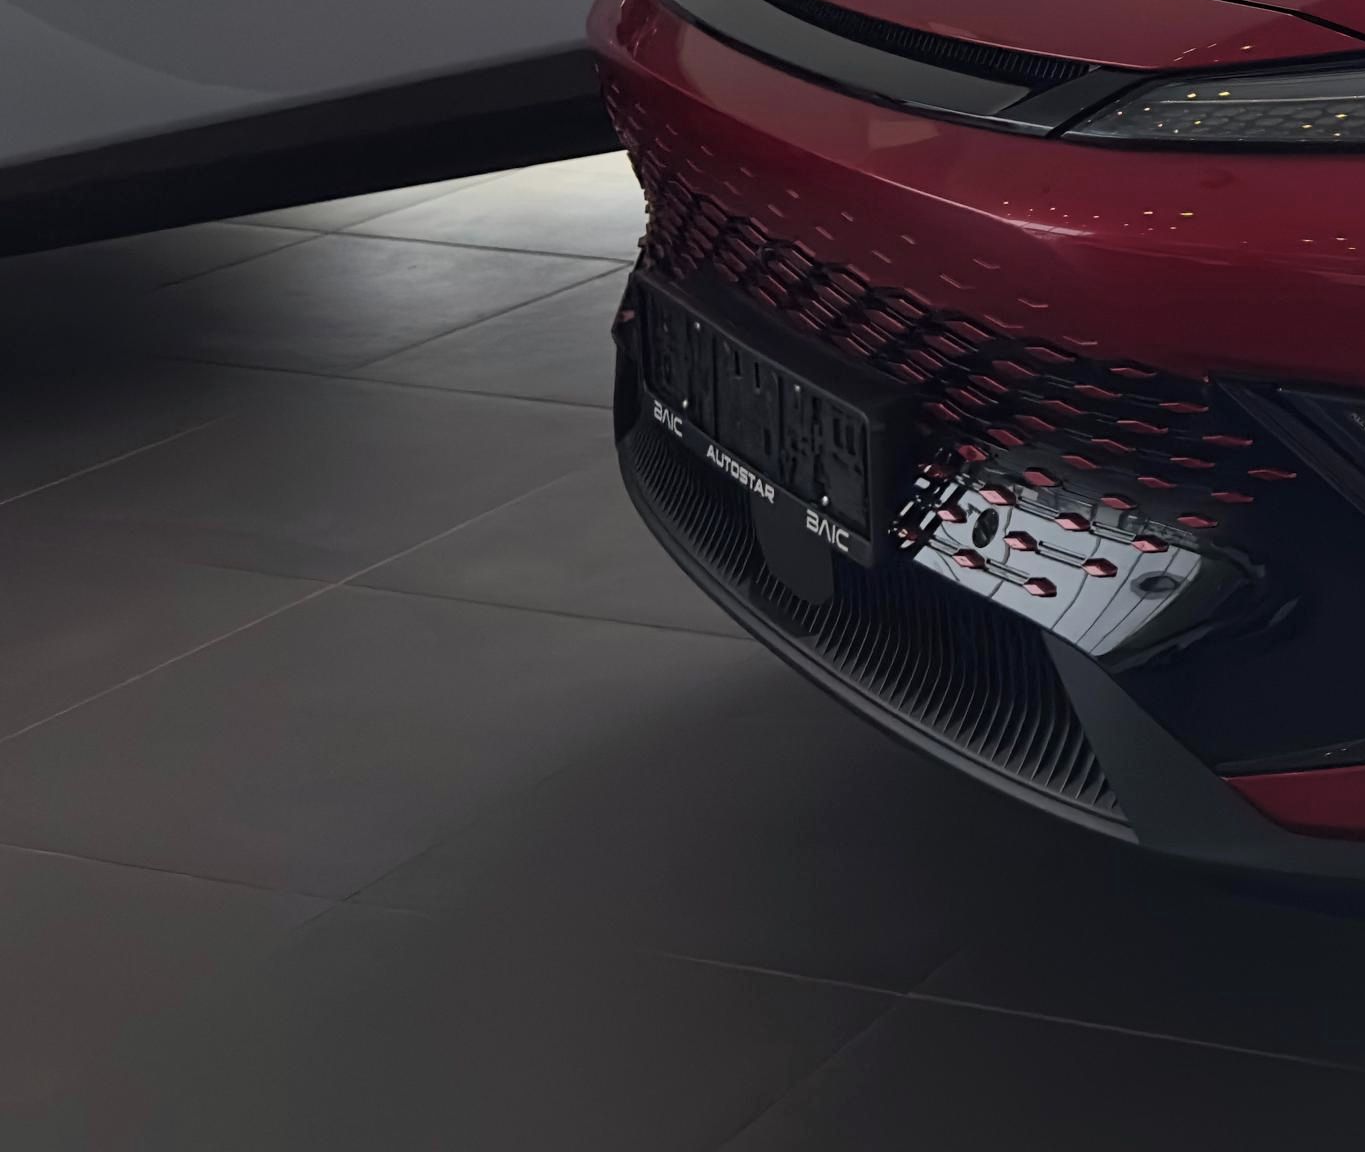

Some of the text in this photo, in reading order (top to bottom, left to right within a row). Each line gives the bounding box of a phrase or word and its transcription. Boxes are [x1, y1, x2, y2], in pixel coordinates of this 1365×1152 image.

[654, 400, 682, 437] BAIC
[706, 444, 775, 504] AUTOSTAR
[806, 508, 849, 552] BAIC
